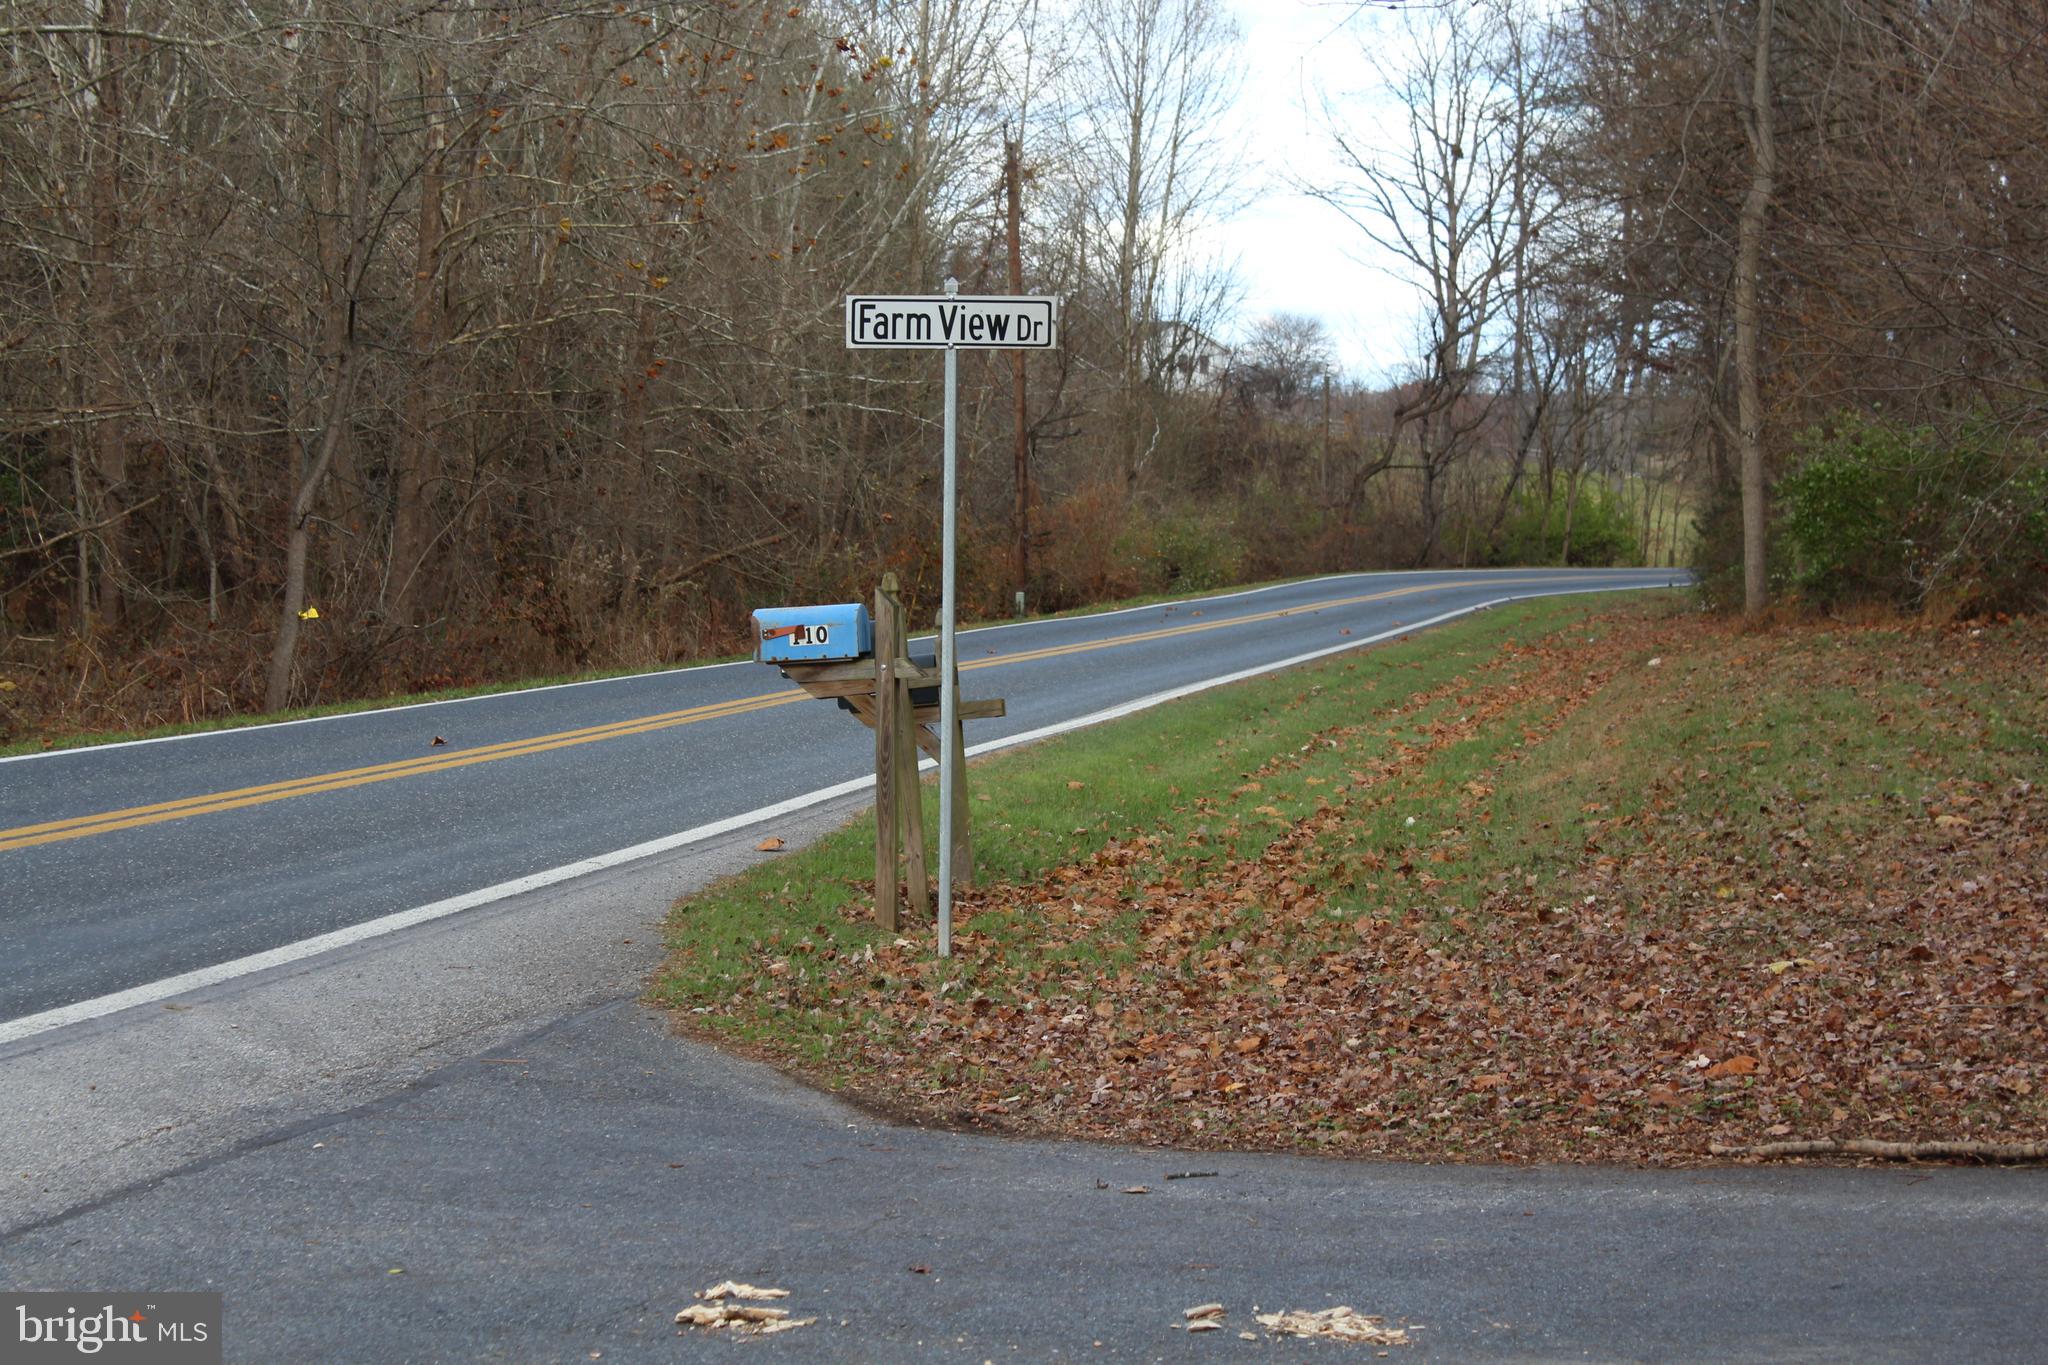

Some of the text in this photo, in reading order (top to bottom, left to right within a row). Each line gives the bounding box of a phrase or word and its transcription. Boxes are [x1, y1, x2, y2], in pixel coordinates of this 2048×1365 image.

[859, 304, 1043, 341] Farm View Dr
